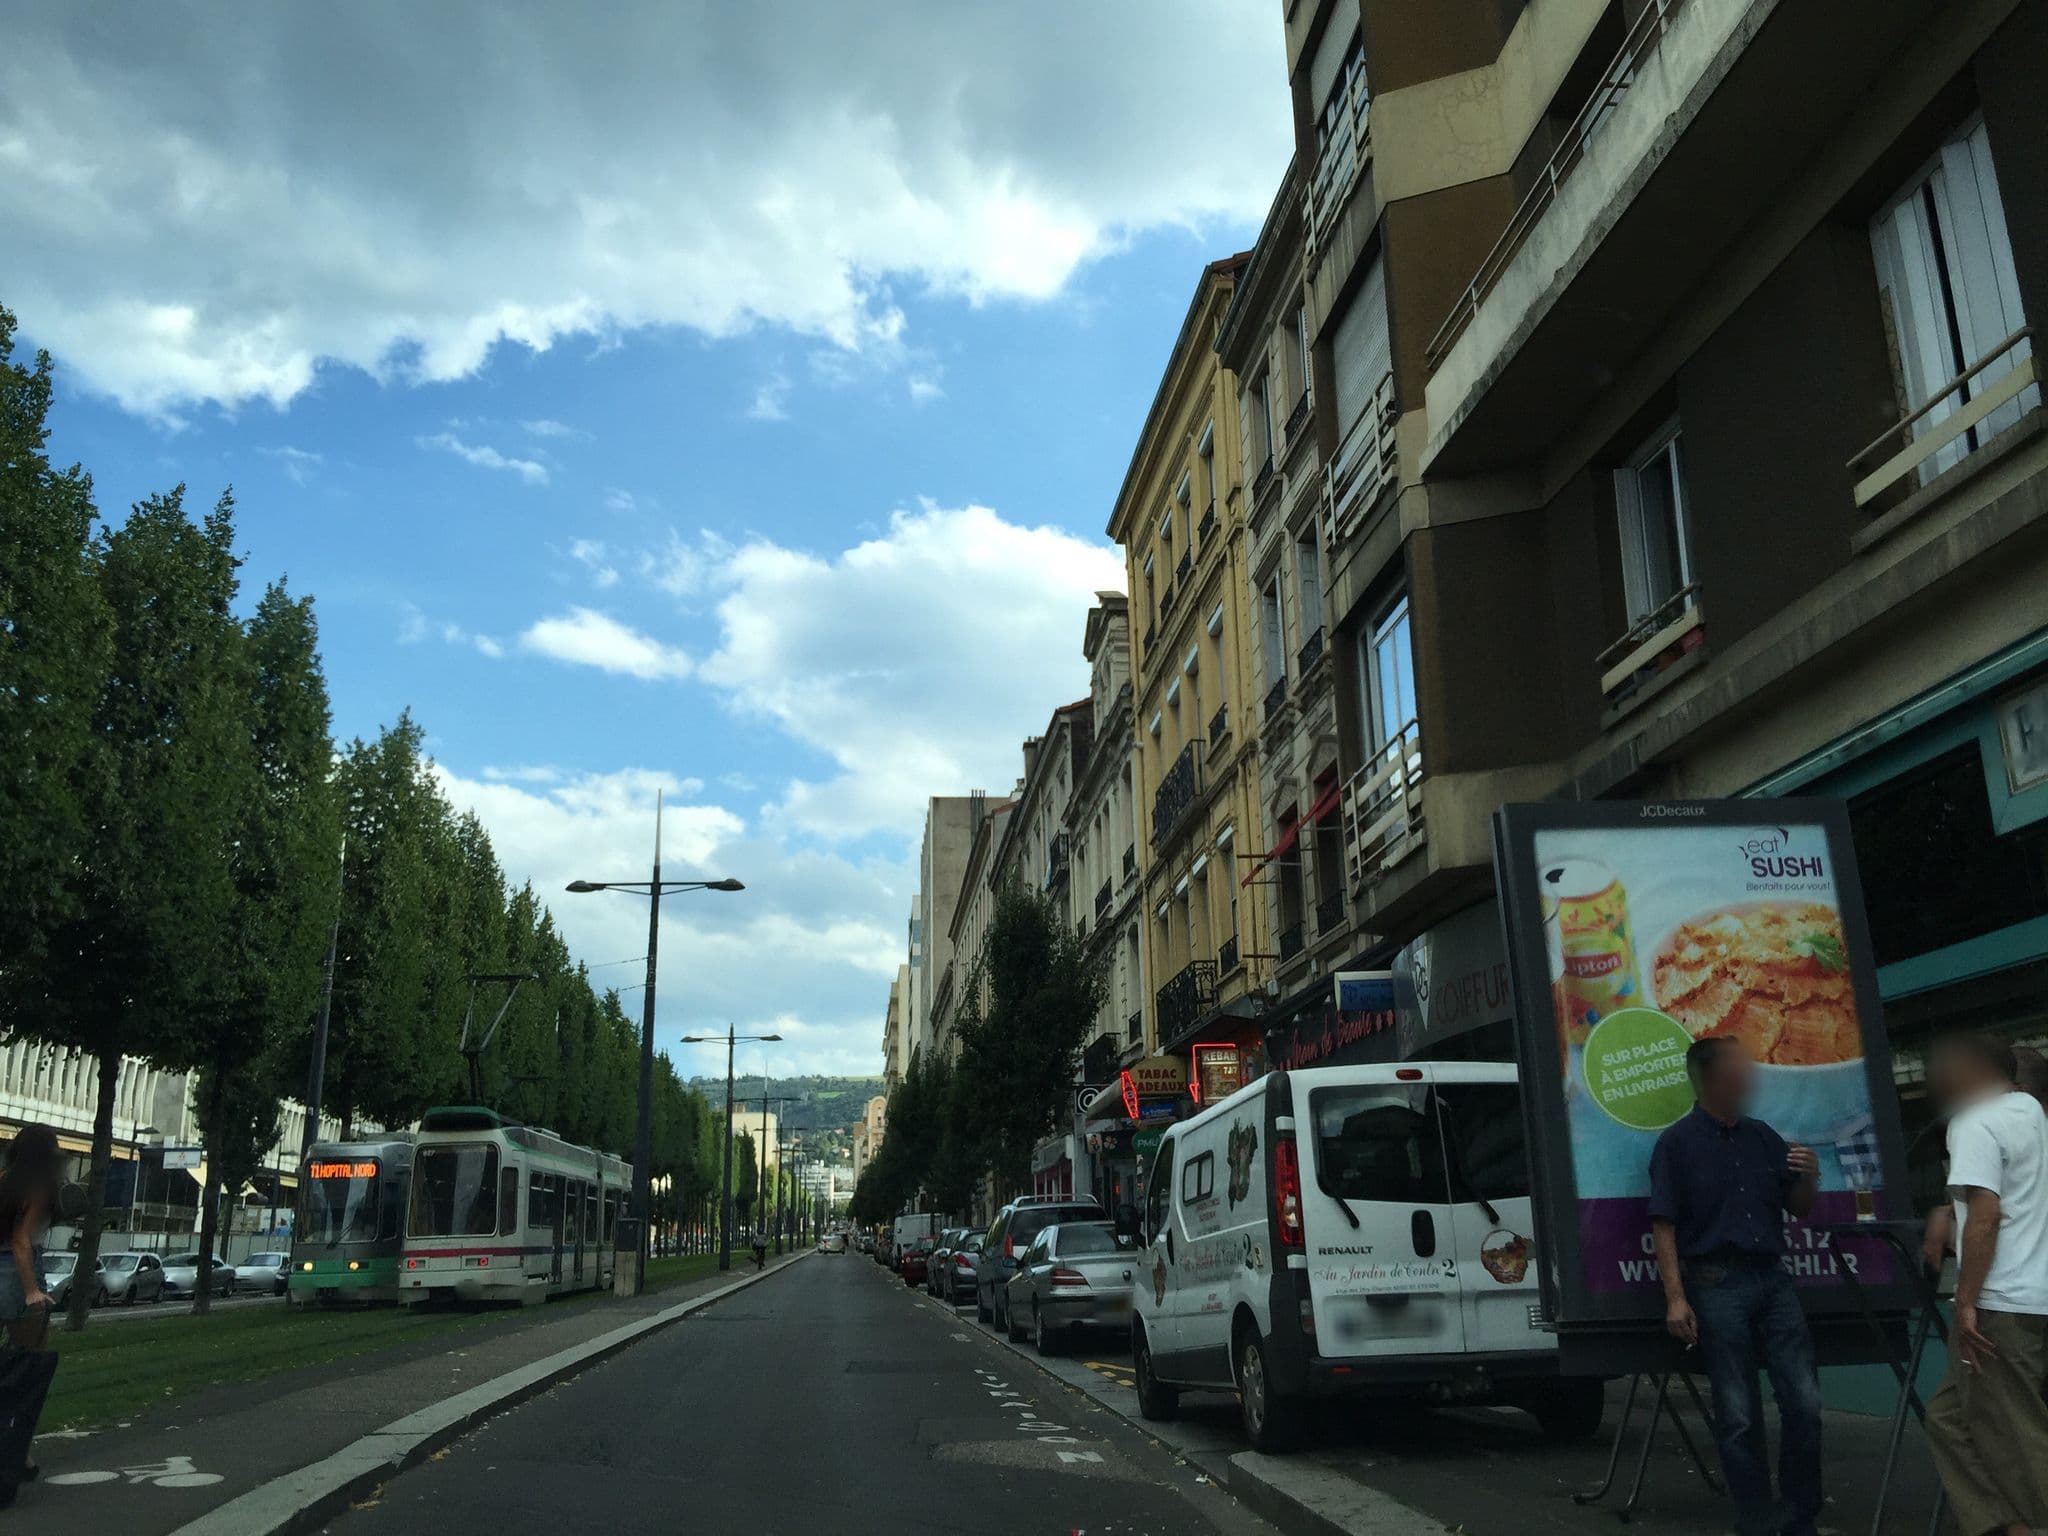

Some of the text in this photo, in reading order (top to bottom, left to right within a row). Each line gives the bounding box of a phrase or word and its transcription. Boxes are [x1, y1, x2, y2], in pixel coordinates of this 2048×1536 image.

[1640, 804, 1705, 817] JCDecaux
[1747, 836, 1779, 853] eat
[1751, 856, 1823, 877] SUSHI
[1573, 956, 1619, 976] pton
[1436, 962, 1510, 1023] COIFFUR
[1203, 1051, 1236, 1061] KEBAB
[1602, 1037, 1679, 1067] SUR PLACE
[1138, 1069, 1177, 1079] TABAC
[1134, 1081, 1185, 1091] ADEAUX
[1602, 1071, 1688, 1102] EN LIVRAISO
[1137, 1138, 1158, 1147] PMU
[354, 1164, 377, 1177] NORD
[1318, 1246, 1373, 1255] RENAULT
[1341, 1263, 1387, 1285] Jardin
[1390, 1262, 1401, 1279] de
[1442, 1258, 1457, 1278] 2
